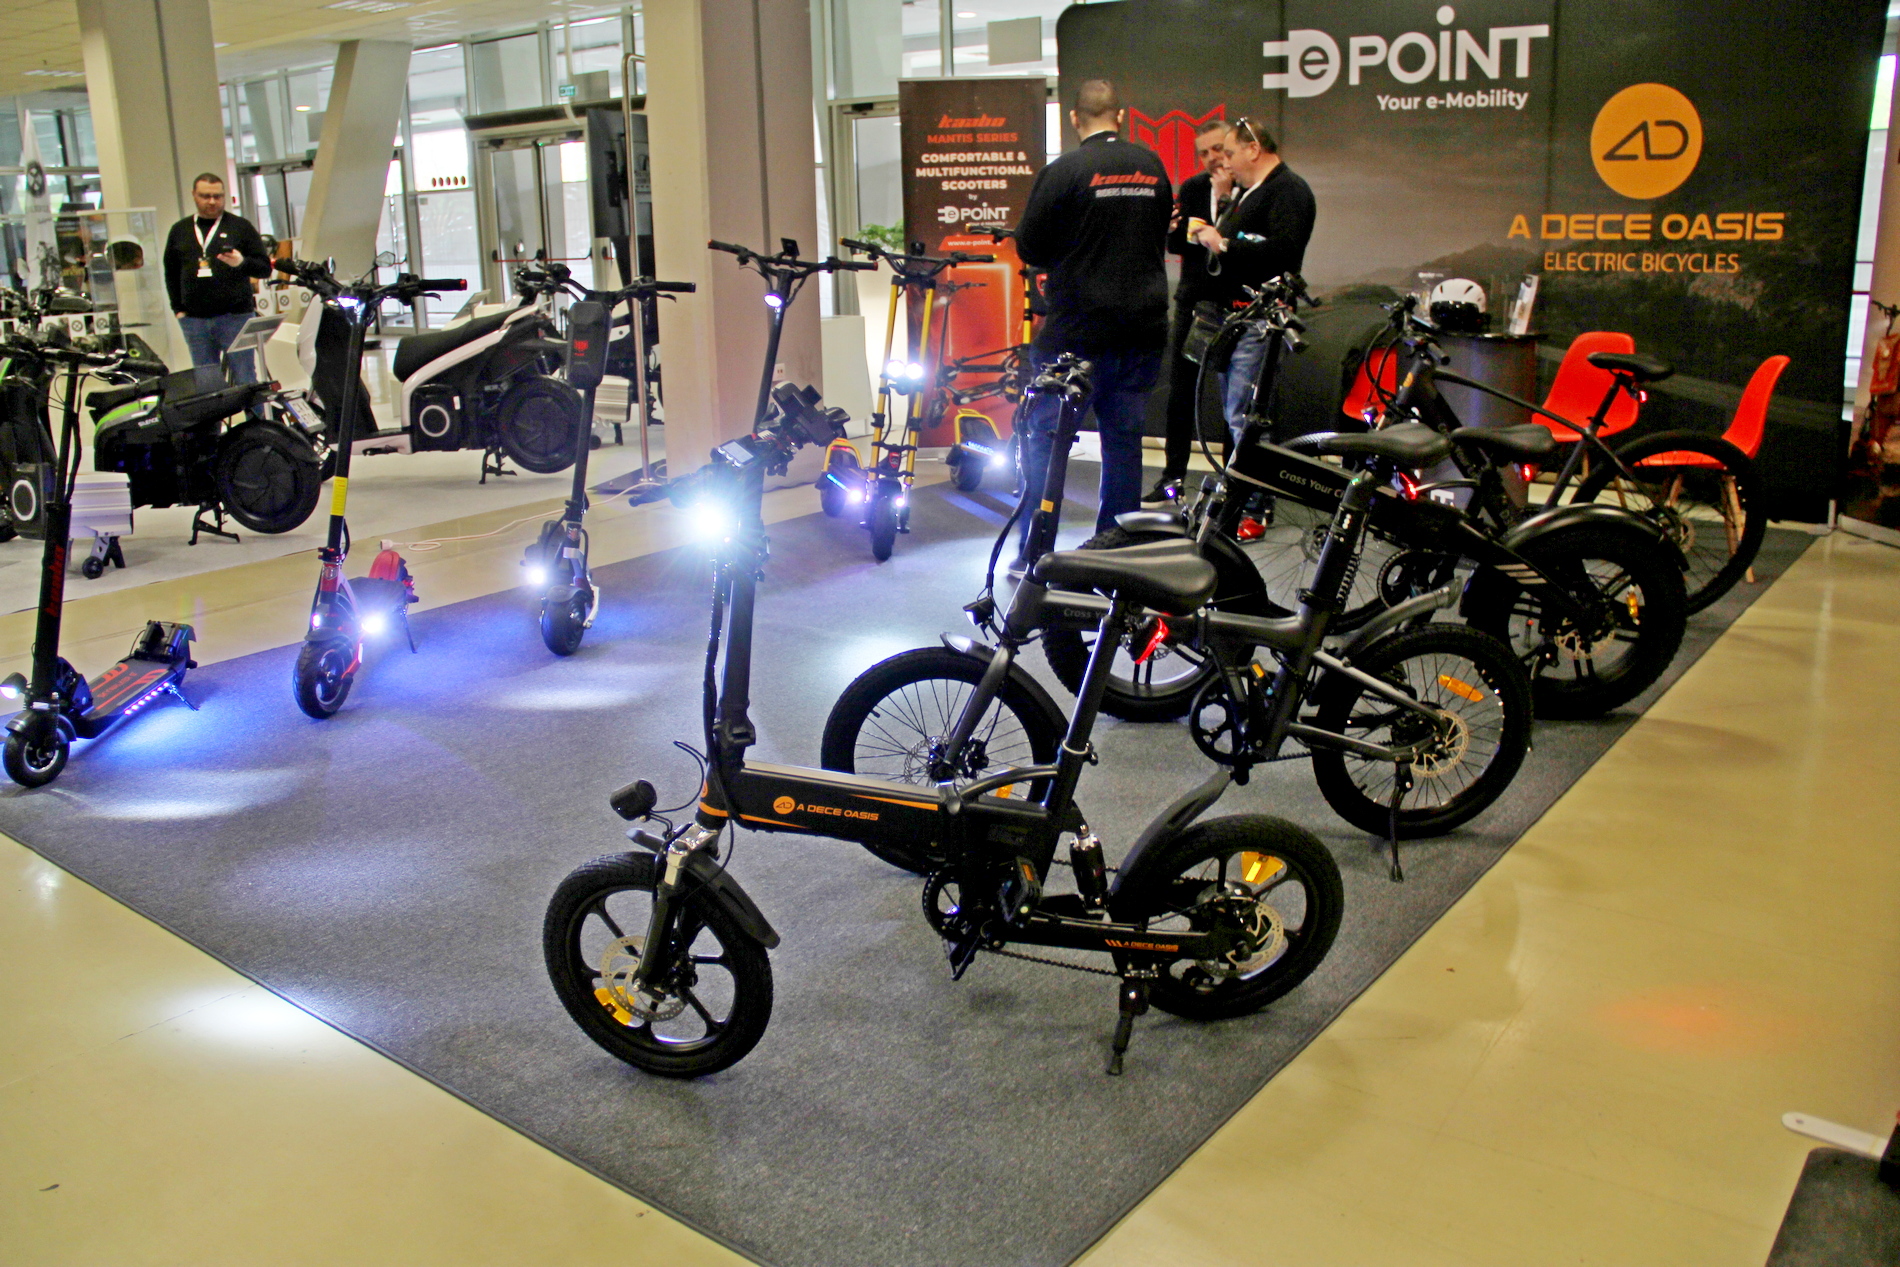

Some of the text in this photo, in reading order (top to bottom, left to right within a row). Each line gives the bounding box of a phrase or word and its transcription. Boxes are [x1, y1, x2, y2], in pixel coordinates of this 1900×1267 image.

[1377, 88, 1529, 110] Your e-Mobility
[927, 133, 1018, 143] MANTIS SERIES
[921, 152, 1026, 163] COMFORTABLE &
[916, 165, 1033, 177] MULTIFUNCTIONAL
[941, 180, 1007, 190] SCOOTERS
[968, 193, 977, 201] by
[1507, 212, 1785, 240] A DECE OASIS
[1544, 252, 1739, 273] ELECTRIC BICYCLES
[1280, 470, 1307, 485] Cross
[1310, 479, 1332, 494] Your
[1064, 608, 1091, 618] Cross
[807, 805, 842, 816] DECE
[844, 810, 879, 821] OASIS
